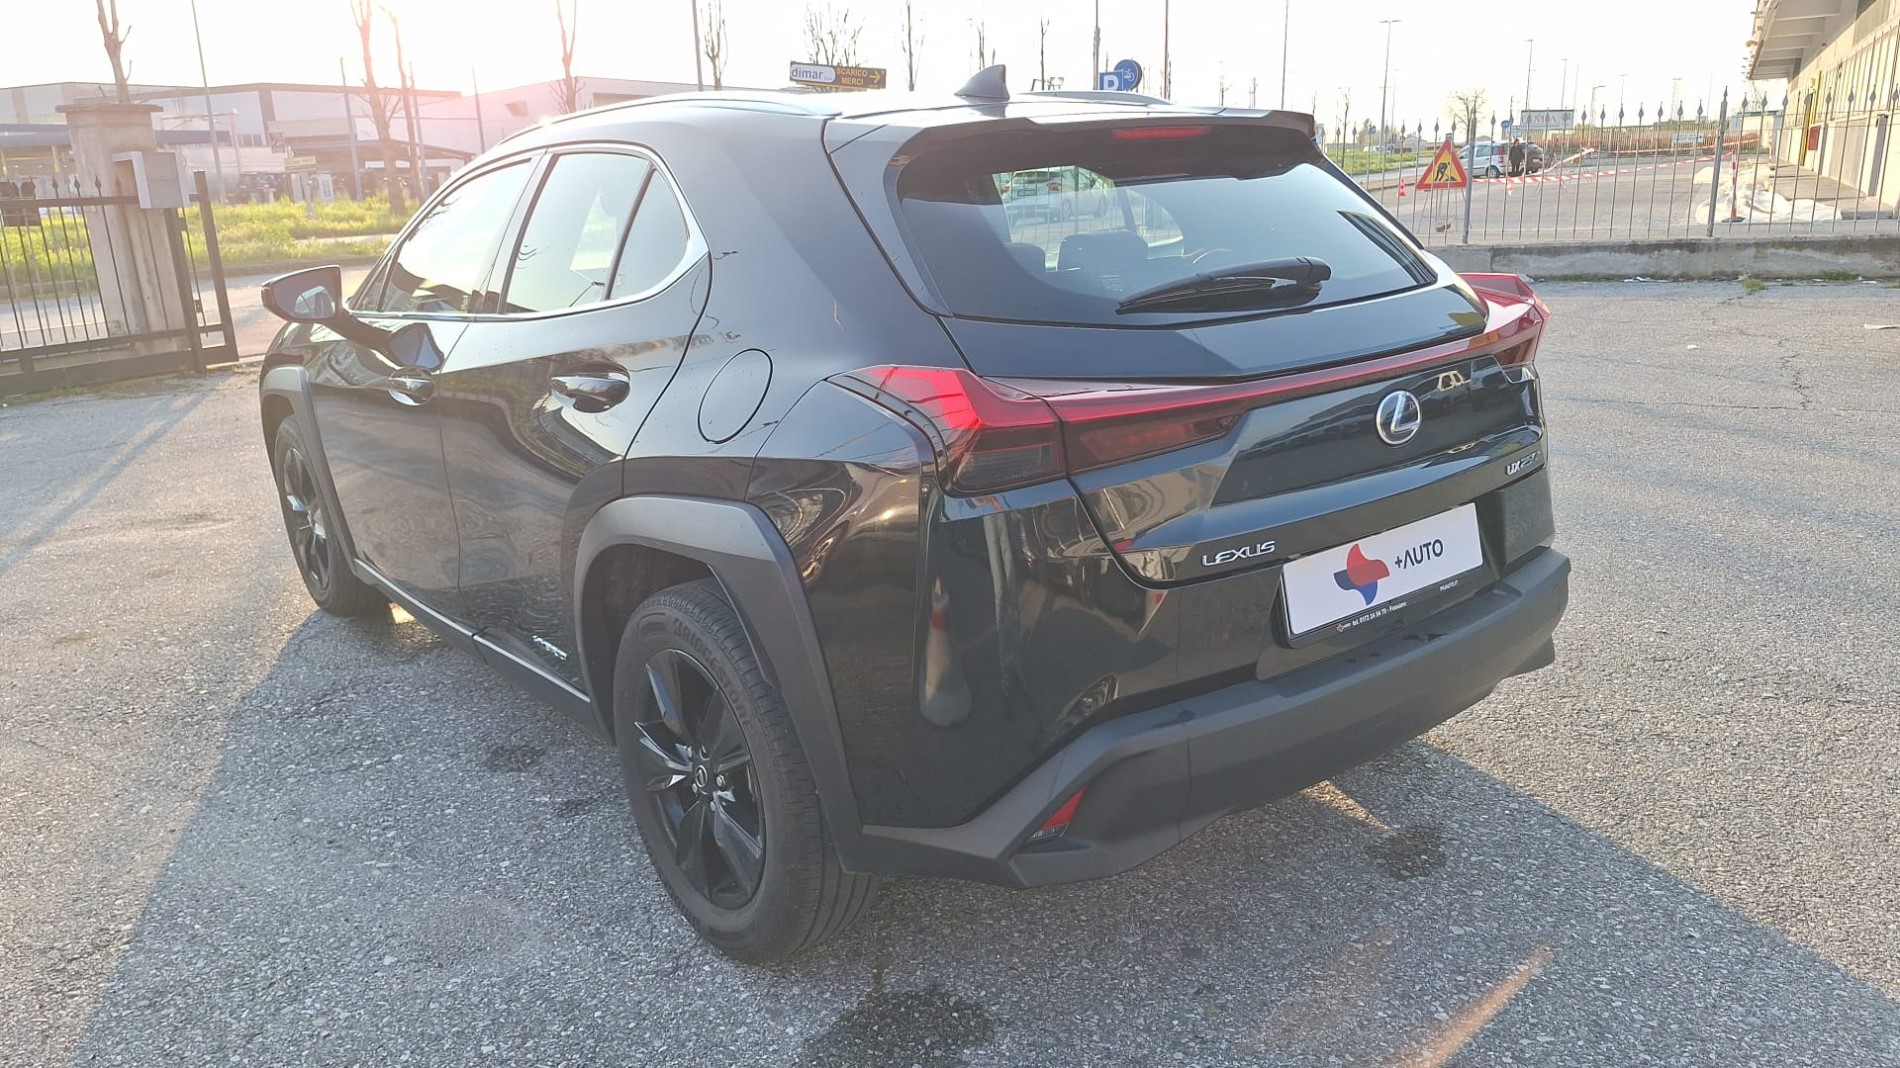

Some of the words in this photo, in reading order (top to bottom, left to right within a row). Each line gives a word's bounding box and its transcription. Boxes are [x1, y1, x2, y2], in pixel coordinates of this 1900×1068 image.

[791, 67, 824, 80] dimar
[836, 67, 868, 77] SCARICO
[841, 76, 864, 86] MERCI
[1202, 540, 1276, 566] LEXUS
